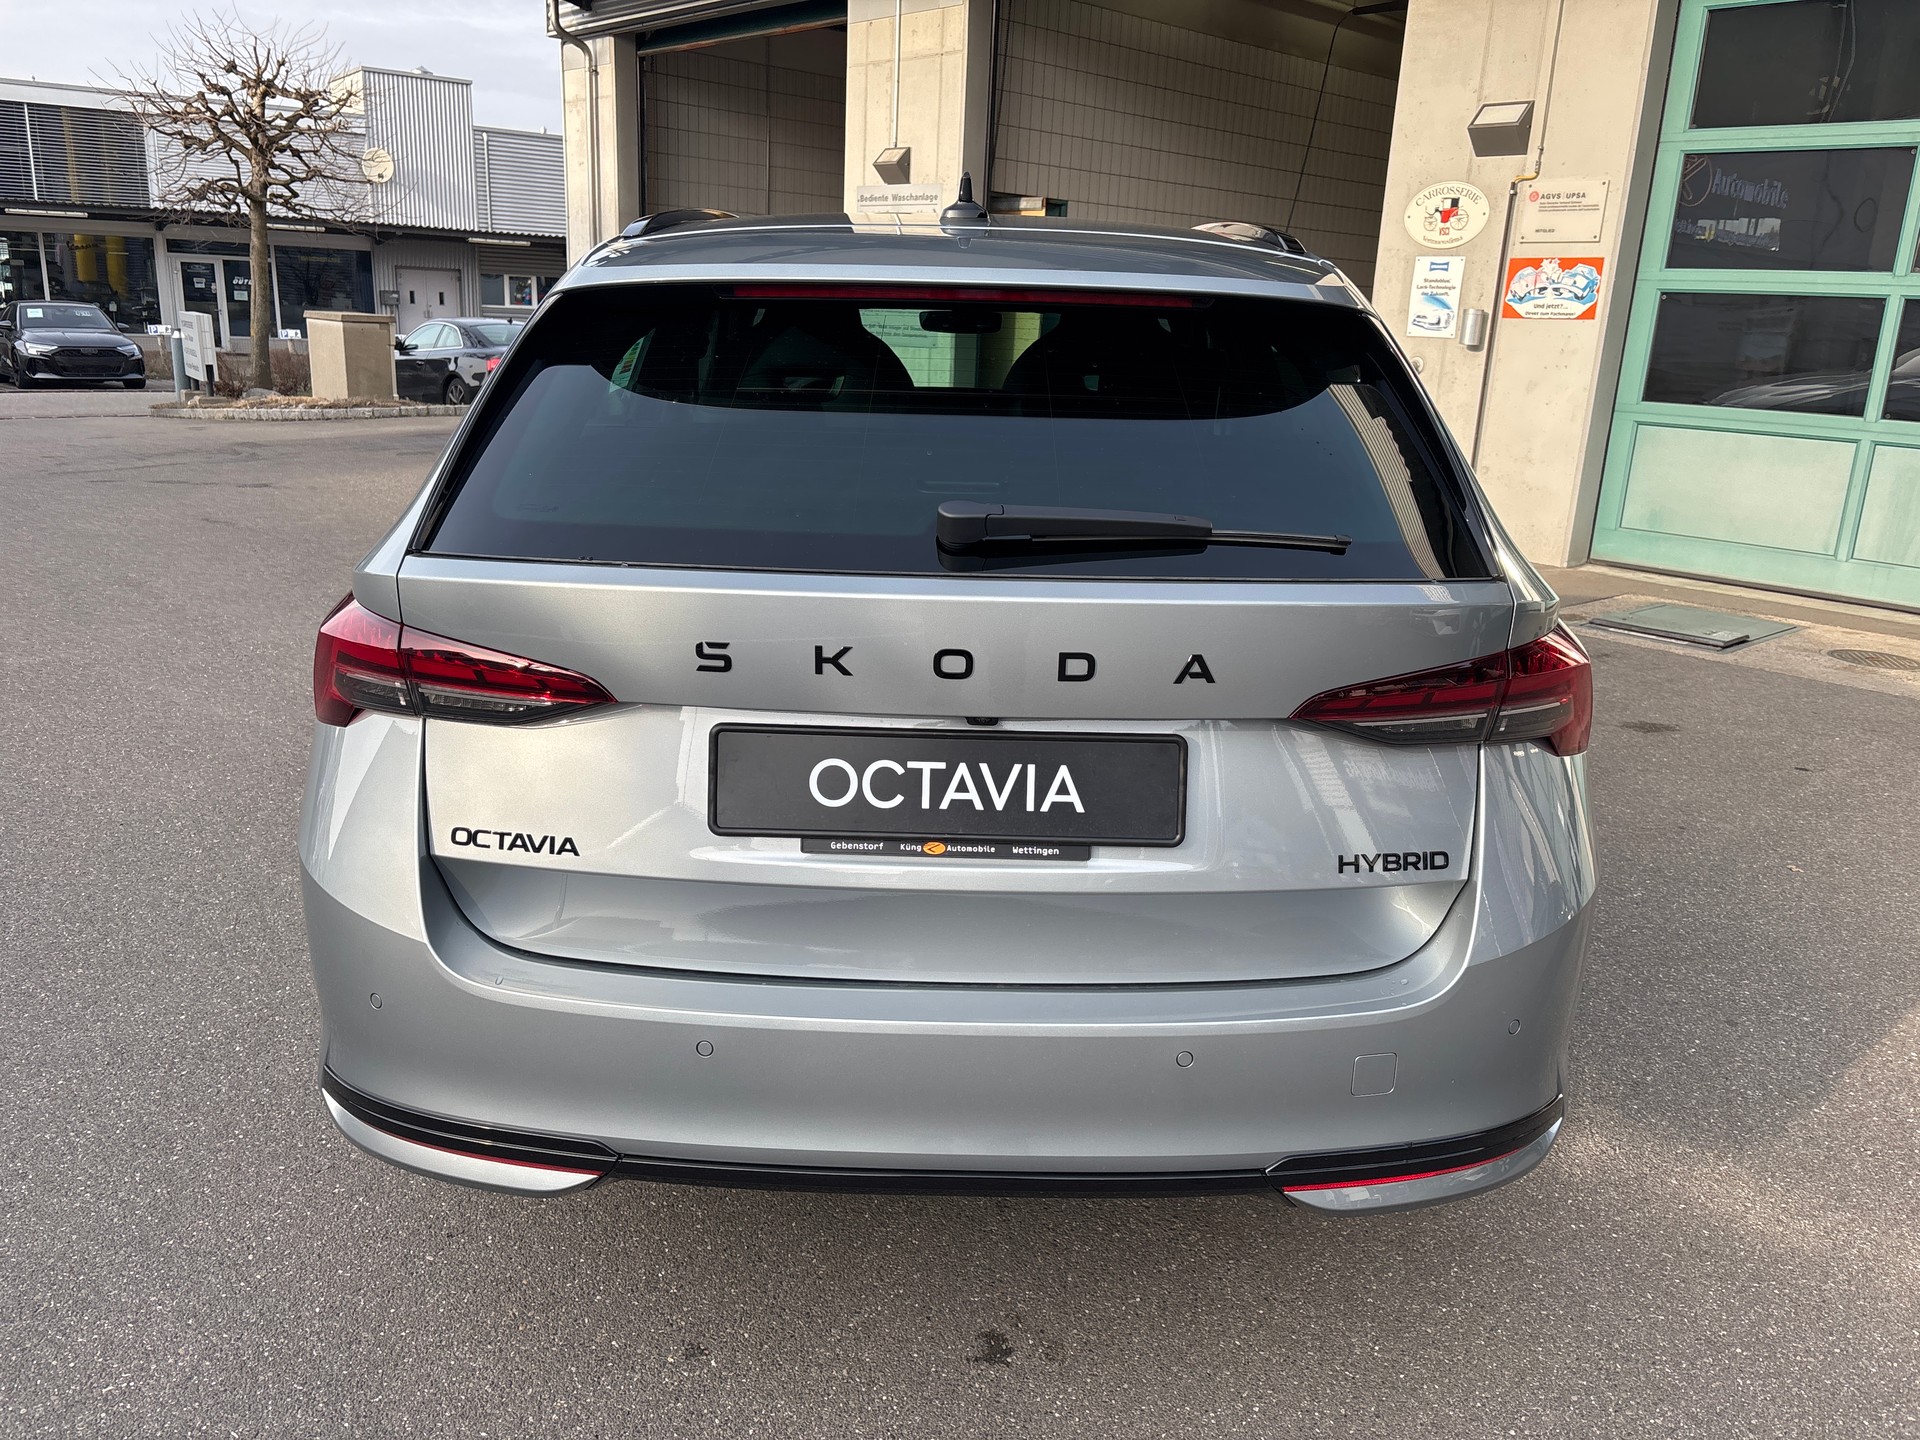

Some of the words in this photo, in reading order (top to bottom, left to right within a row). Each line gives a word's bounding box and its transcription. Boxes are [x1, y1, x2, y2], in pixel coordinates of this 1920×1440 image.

[891, 192, 939, 202] Waschanlage
[1415, 186, 1482, 206] CARROSSERIE
[808, 757, 1086, 814] OCTAVIA
[450, 826, 581, 857] OCTAVIA
[830, 841, 884, 851] Gebenstorf
[900, 843, 922, 853] Küng
[946, 844, 996, 854] Automobile
[1012, 845, 1060, 856] Wettingen
[1337, 850, 1450, 874] HYBRID
